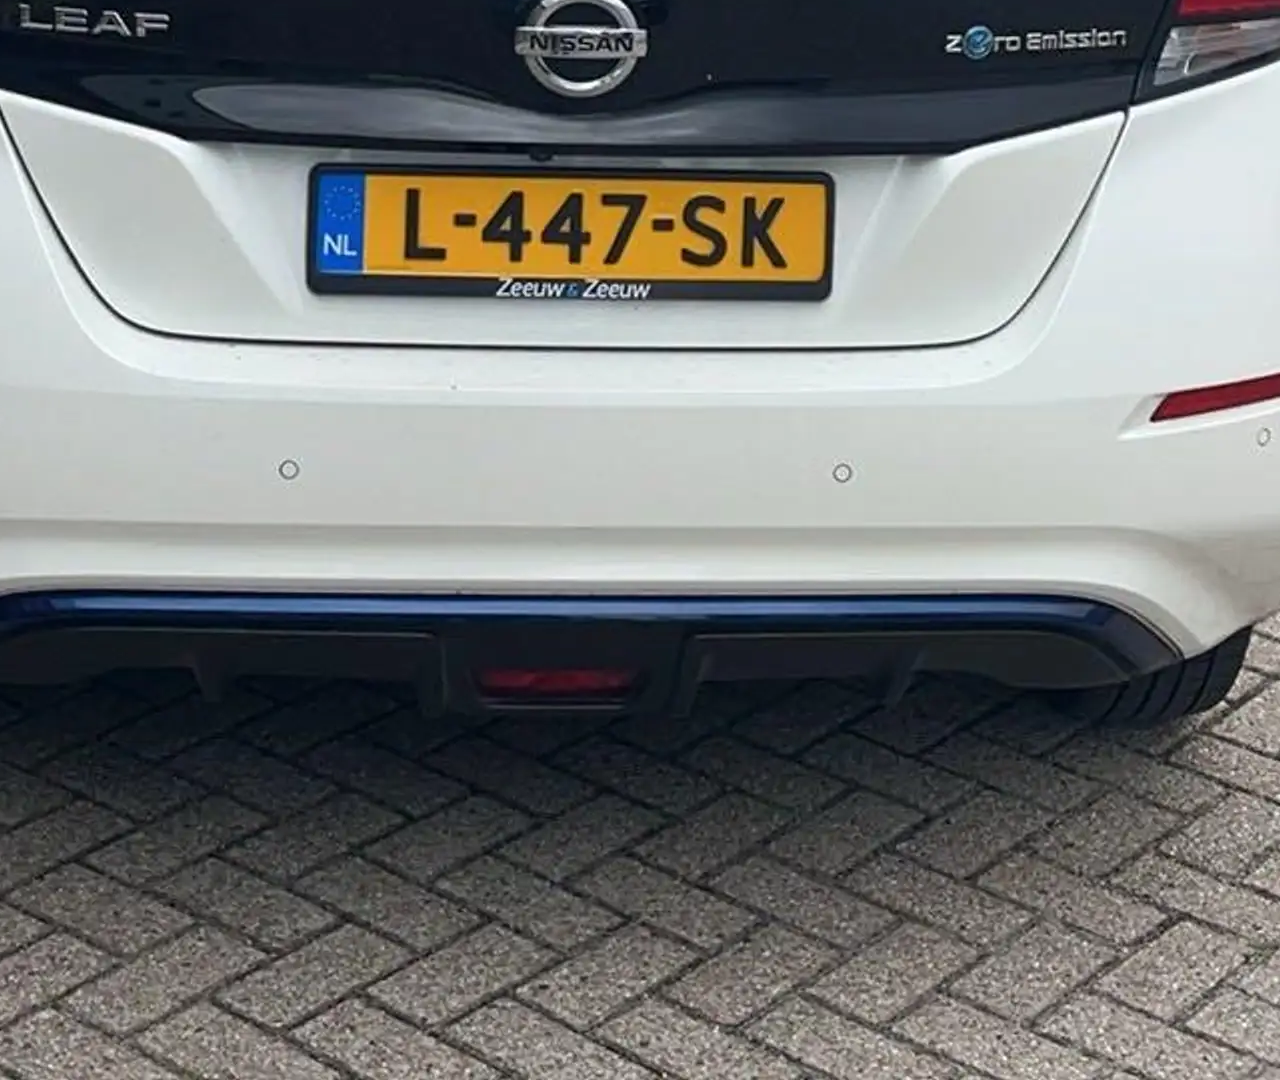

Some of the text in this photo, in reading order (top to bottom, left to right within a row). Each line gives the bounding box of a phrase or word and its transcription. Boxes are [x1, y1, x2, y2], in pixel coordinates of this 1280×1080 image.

[18, 3, 171, 38] LEAF
[529, 32, 634, 52] NISSAN
[402, 187, 788, 269] L-447-SK
[322, 233, 357, 256] NL
[496, 277, 566, 297] Zeeuw
[582, 278, 652, 299] Zeeuw
